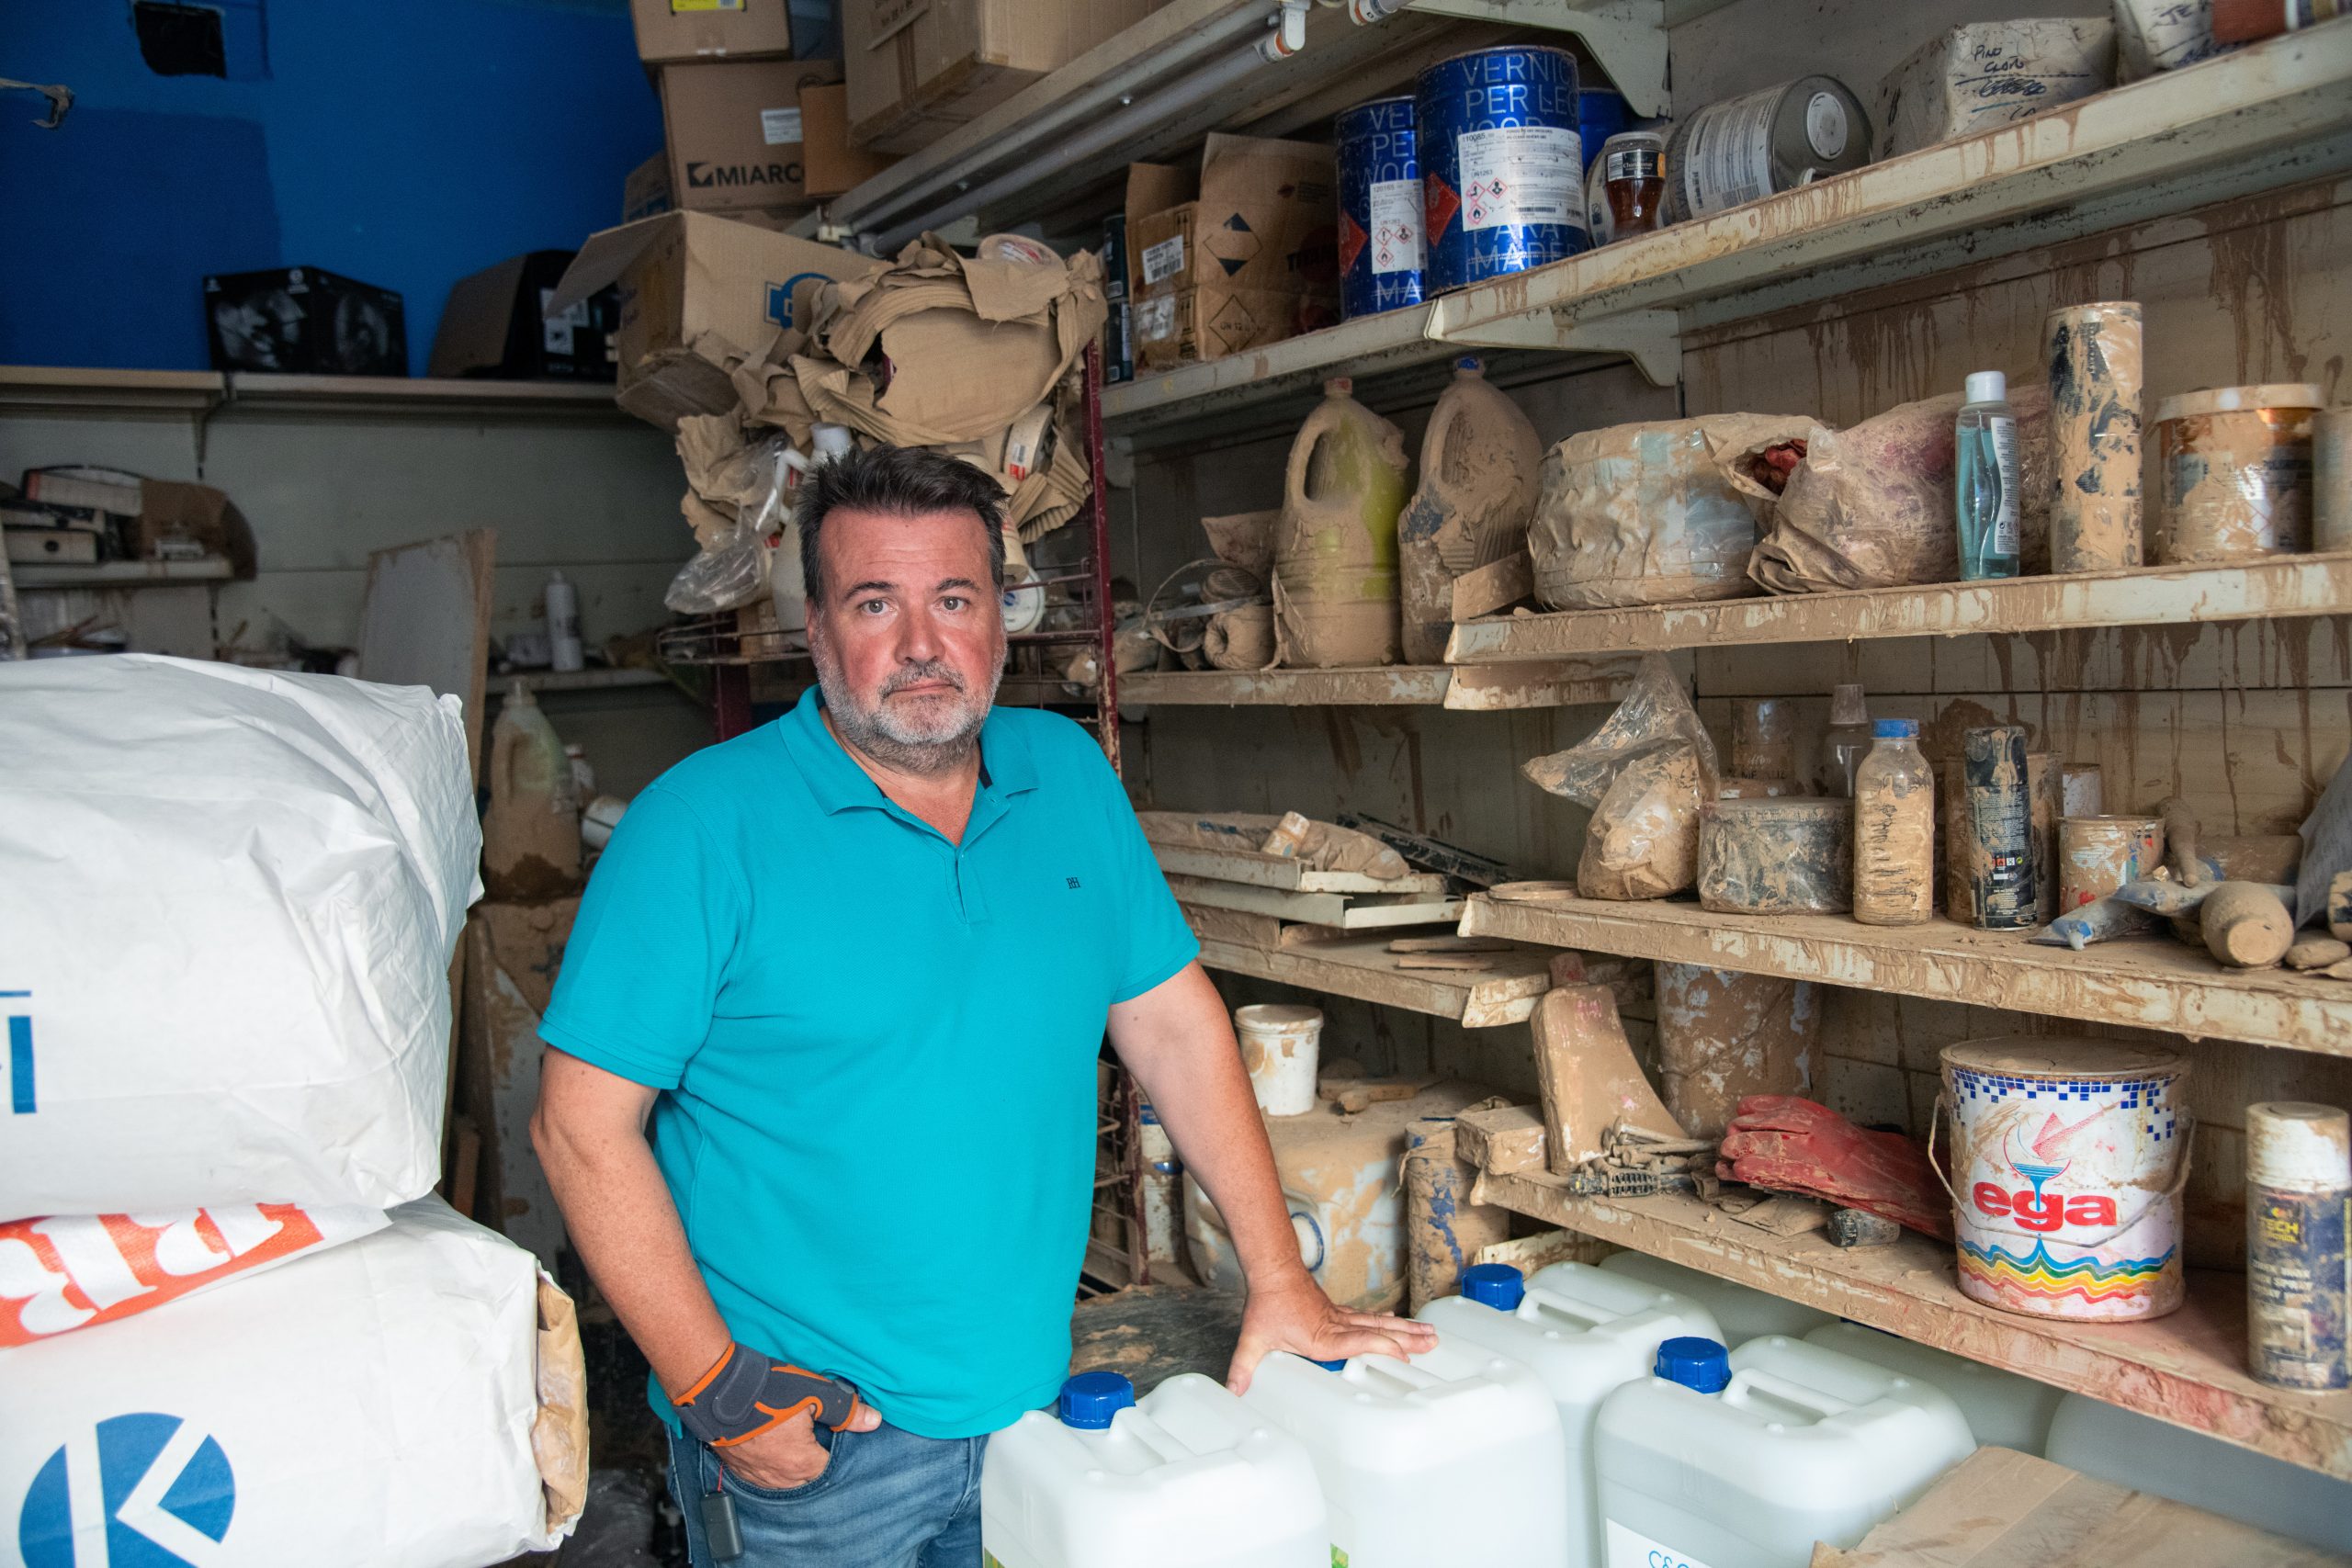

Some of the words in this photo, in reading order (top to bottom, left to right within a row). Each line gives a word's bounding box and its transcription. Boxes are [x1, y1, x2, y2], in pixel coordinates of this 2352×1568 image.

[1370, 104, 1415, 131] VE
[1464, 85, 1529, 118] PER
[1372, 130, 1416, 161] PE
[1973, 1181, 2117, 1232] ega
